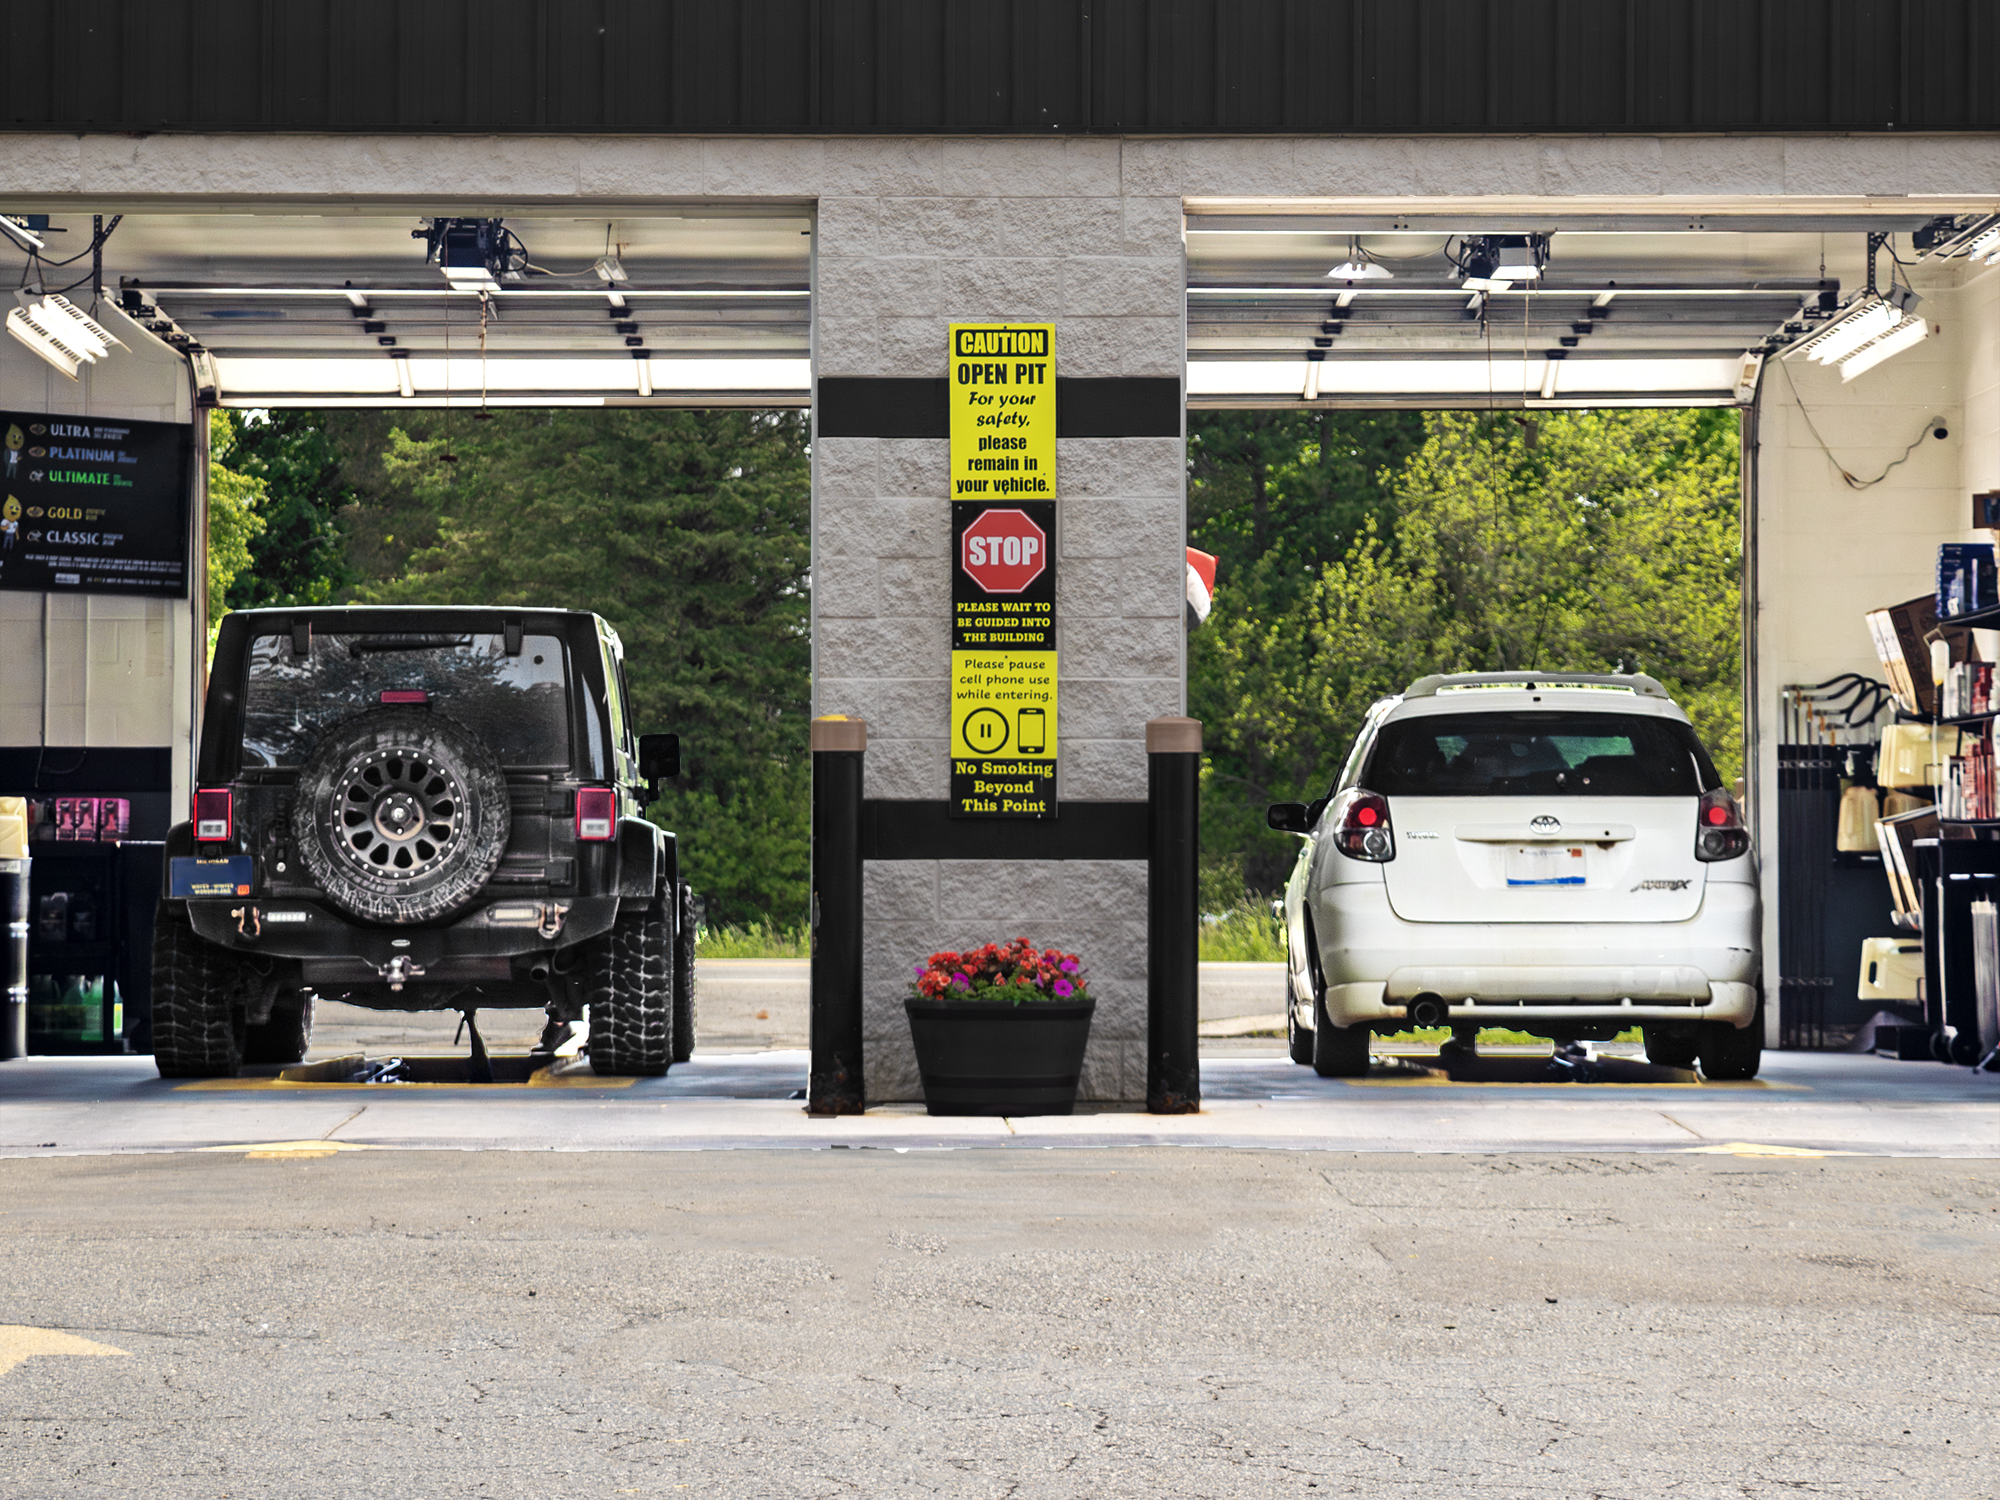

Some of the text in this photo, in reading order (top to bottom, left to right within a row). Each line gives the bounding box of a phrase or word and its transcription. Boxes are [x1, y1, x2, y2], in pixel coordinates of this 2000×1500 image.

[960, 332, 1044, 354] CAUTION
[957, 363, 1047, 385] OPEN PIT
[969, 392, 1036, 408] For your
[976, 412, 1030, 428] safety,
[50, 423, 91, 438] ULTRA
[978, 435, 1027, 451] please
[49, 446, 115, 463] PLATINUM
[968, 456, 1038, 471] remain in
[49, 470, 110, 485] ULTIMATE
[956, 477, 1050, 493] your vehicle.
[47, 506, 82, 520] GOLD
[46, 530, 100, 546] CLASSIC
[969, 536, 1039, 566] STOP
[957, 602, 1051, 612] PLEASE WAIT TO
[957, 617, 1051, 628] BE GUIDED INTO
[963, 632, 1045, 643] THE BUILDING
[964, 658, 1046, 671] Please pause
[959, 674, 982, 684] cell
[986, 674, 1025, 686] phone
[956, 689, 1053, 702] while entering.
[955, 761, 1054, 779] No Smoking
[973, 780, 1035, 797] Beyond
[961, 798, 1046, 812] This Point
